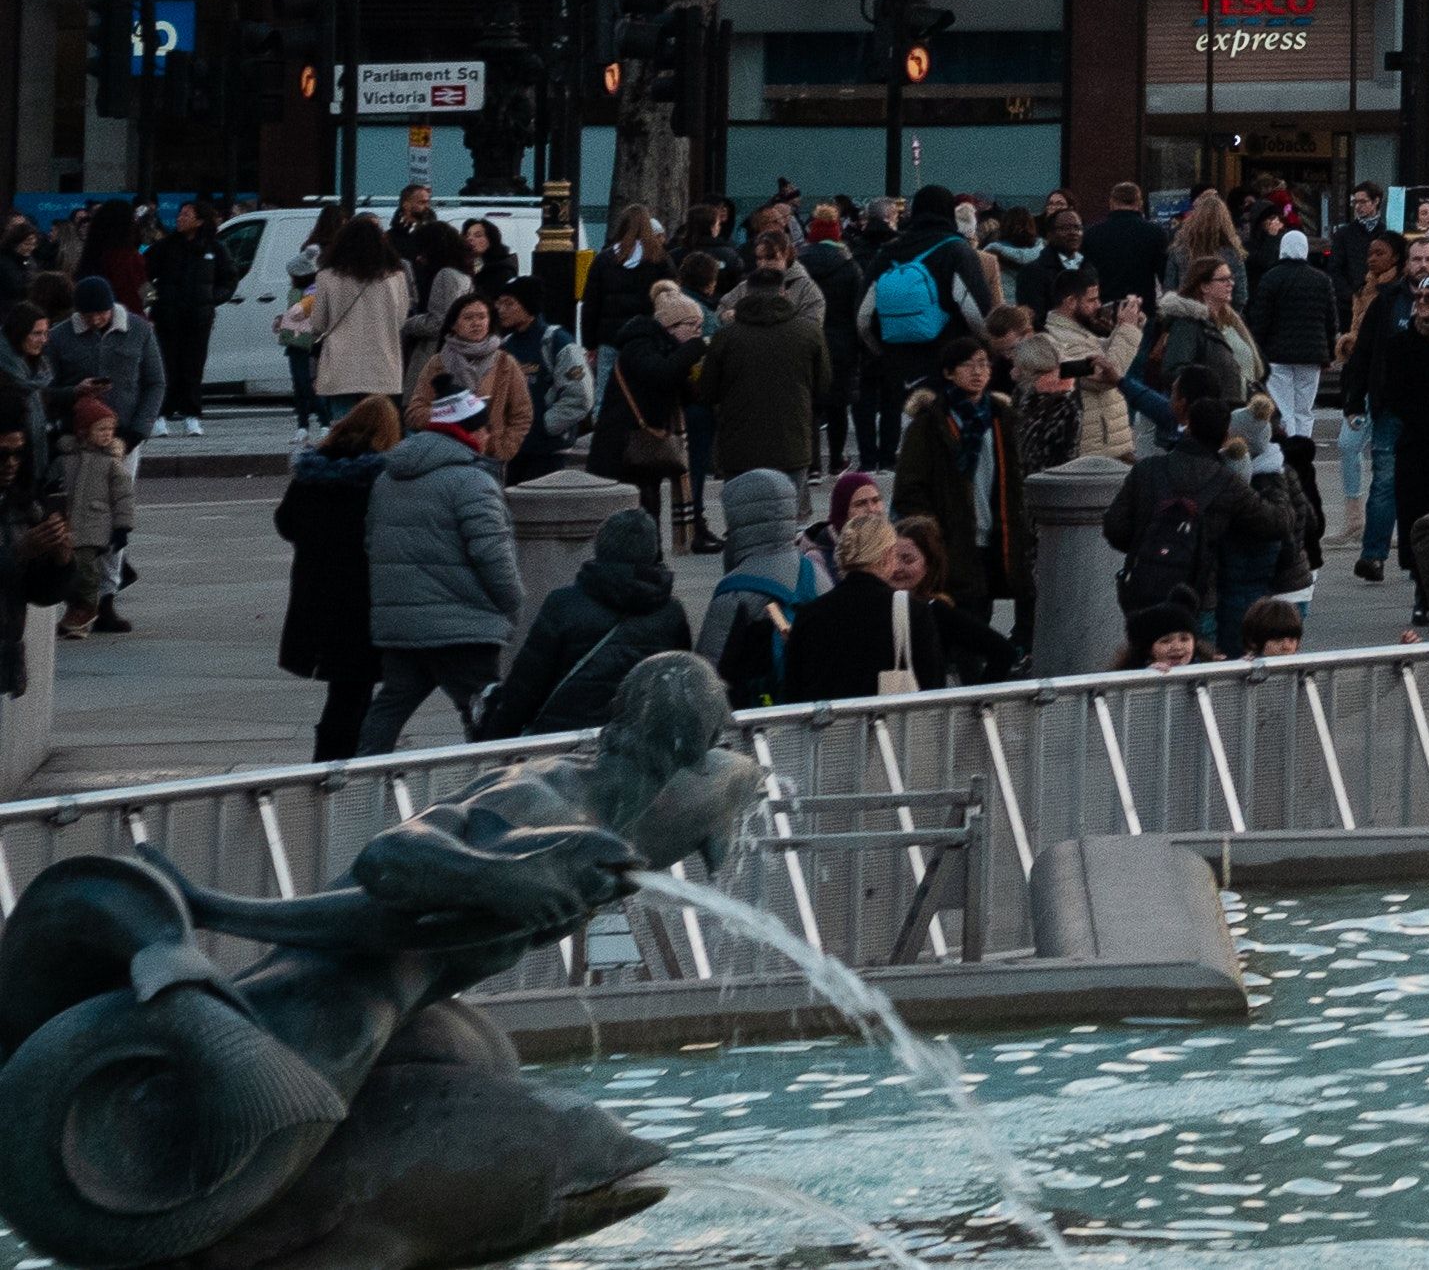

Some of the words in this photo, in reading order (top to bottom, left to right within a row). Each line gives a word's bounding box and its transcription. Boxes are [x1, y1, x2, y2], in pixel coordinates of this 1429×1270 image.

[1196, 29, 1308, 58] express
[362, 69, 450, 83] Parliament
[457, 68, 478, 81] Sq
[363, 91, 426, 105] Victoria
